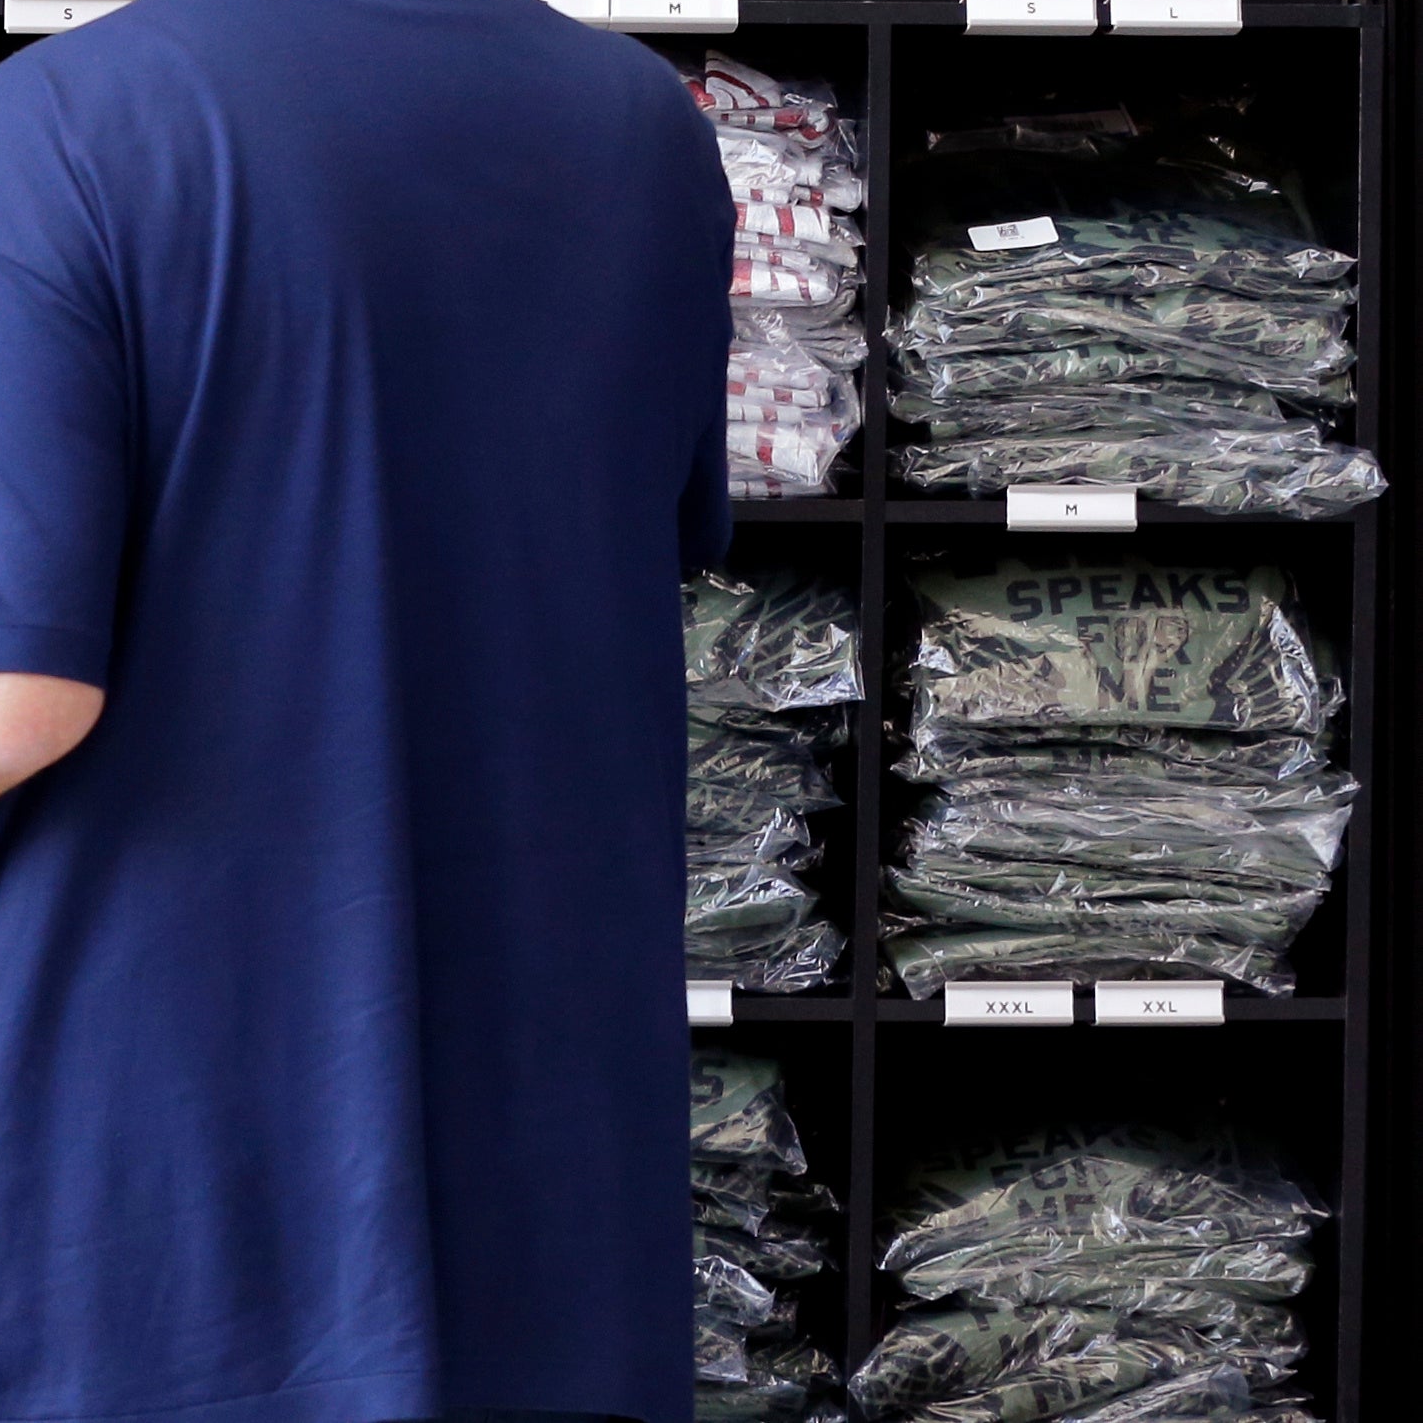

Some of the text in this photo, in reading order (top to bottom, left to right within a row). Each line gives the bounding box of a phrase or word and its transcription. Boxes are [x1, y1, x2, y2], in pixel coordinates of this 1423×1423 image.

[63, 8, 73, 20] S
[669, 3, 681, 14] M
[1027, 2, 1036, 14] S
[1170, 6, 1179, 18] L
[1065, 503, 1078, 516] M
[1006, 573, 1250, 624] SPEAKS
[1096, 666, 1182, 714] ME
[985, 1001, 1034, 1014] XXXL
[1142, 1001, 1178, 1013] XXL
